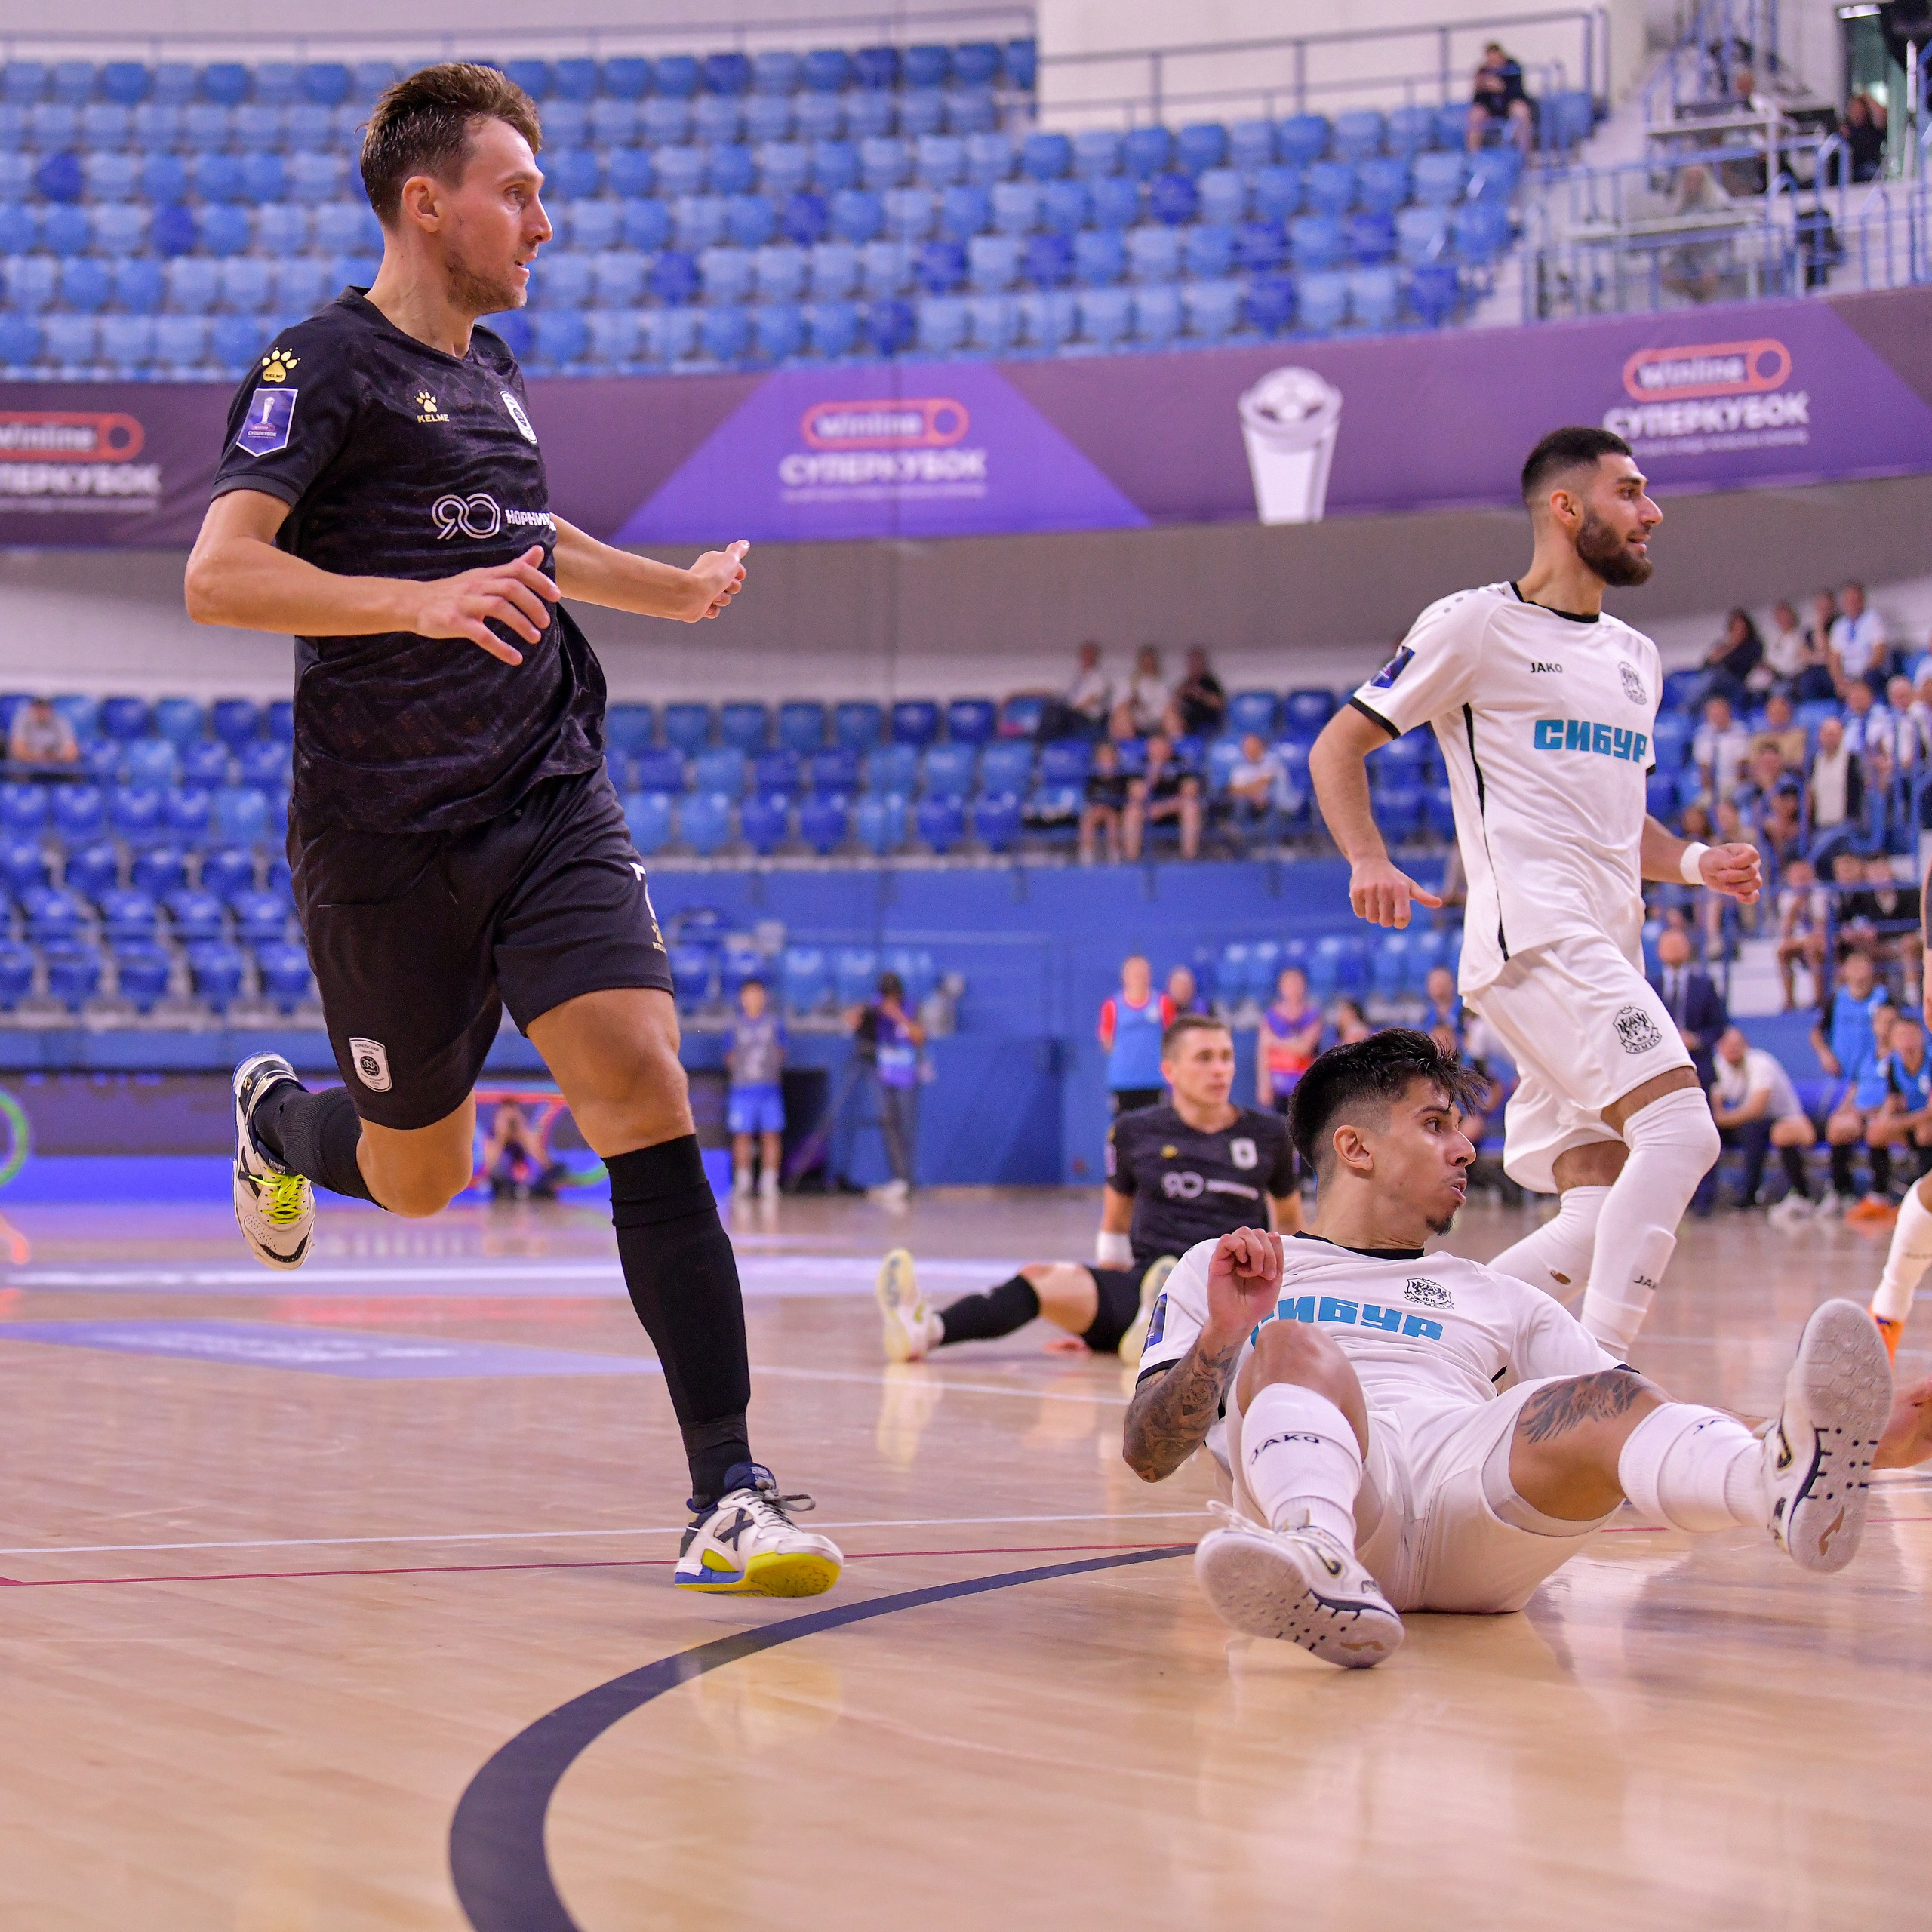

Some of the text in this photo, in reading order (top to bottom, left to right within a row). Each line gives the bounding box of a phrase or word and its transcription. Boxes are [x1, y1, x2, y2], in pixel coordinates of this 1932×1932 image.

[417, 414, 450, 423] KELME
[431, 493, 501, 540] 90
[1531, 662, 1563, 673] JAKO
[1534, 719, 1647, 763] СИБУР
[1250, 1296, 1443, 1349] ИБУР
[1251, 1435, 1320, 1465] JAKO
